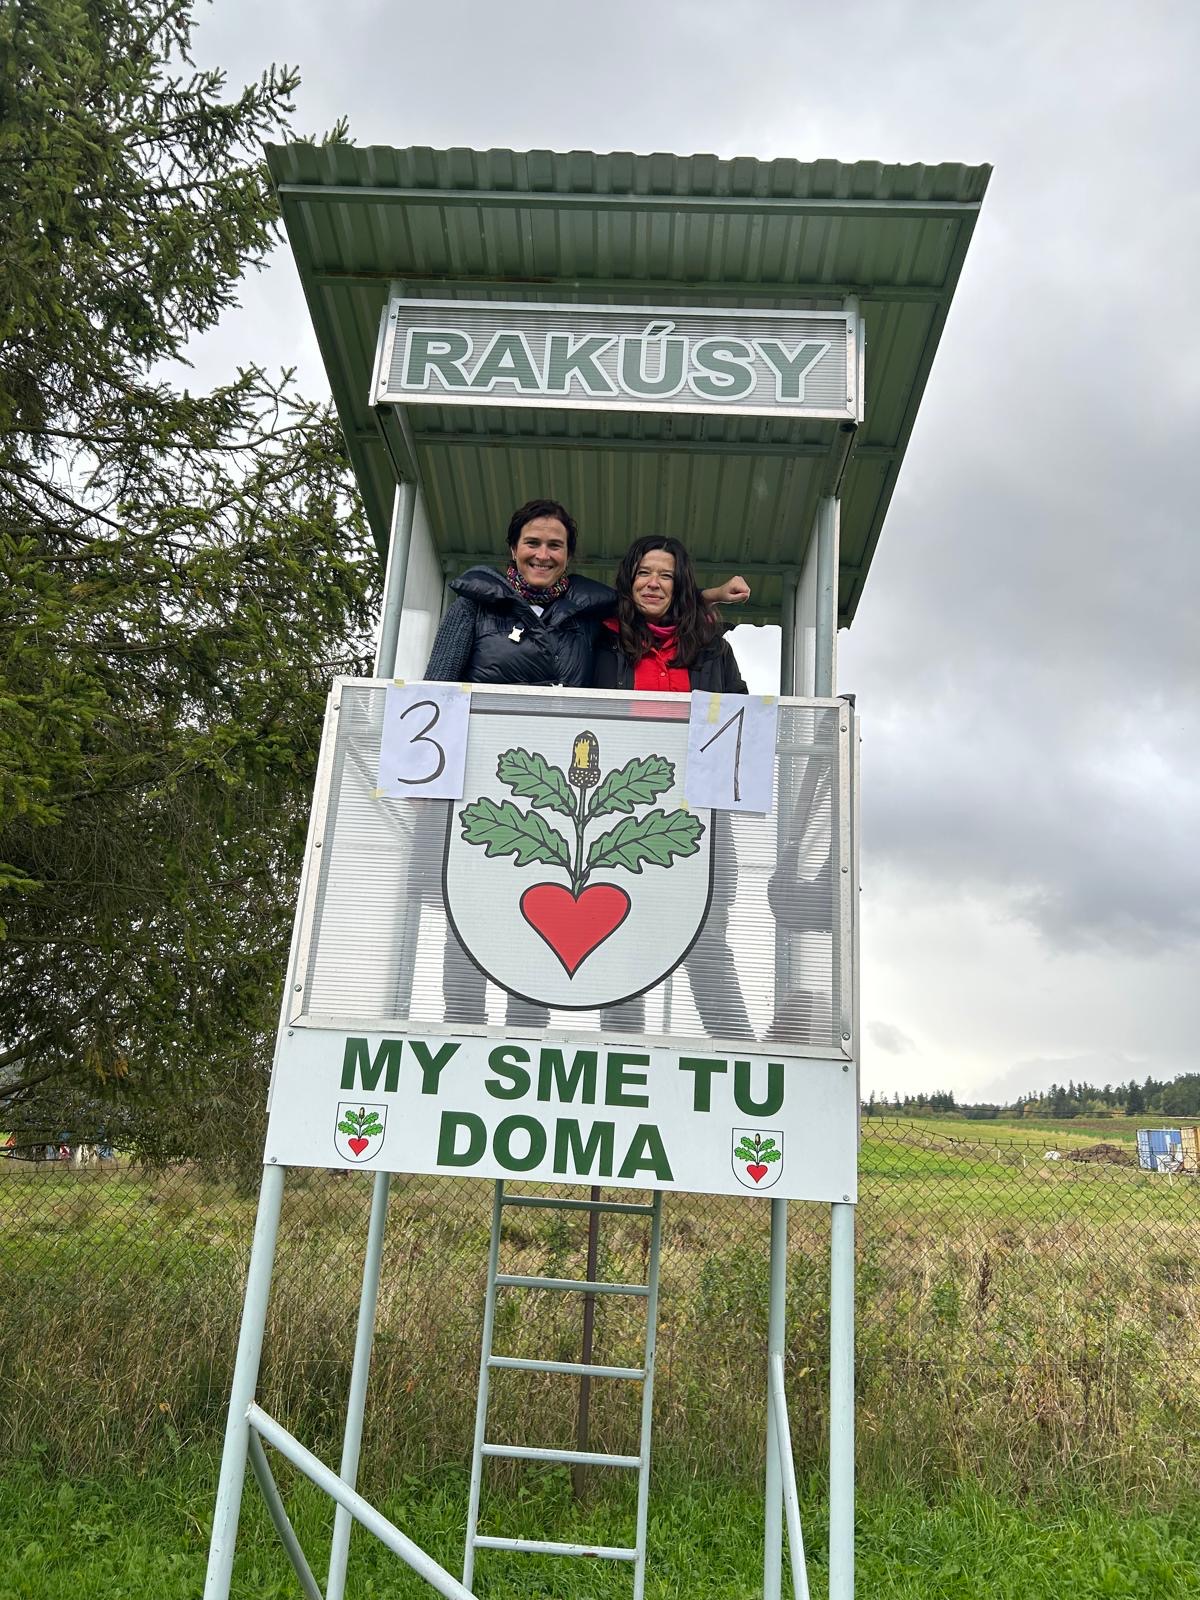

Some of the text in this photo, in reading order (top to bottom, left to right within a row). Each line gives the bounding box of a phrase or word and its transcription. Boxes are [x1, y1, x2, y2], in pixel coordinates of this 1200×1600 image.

[401, 320, 831, 402] RAKÚSY
[397, 700, 447, 785] 3
[699, 706, 745, 802] 1
[339, 1037, 785, 1117] MY SME TU
[436, 1110, 675, 1182] DOMA
